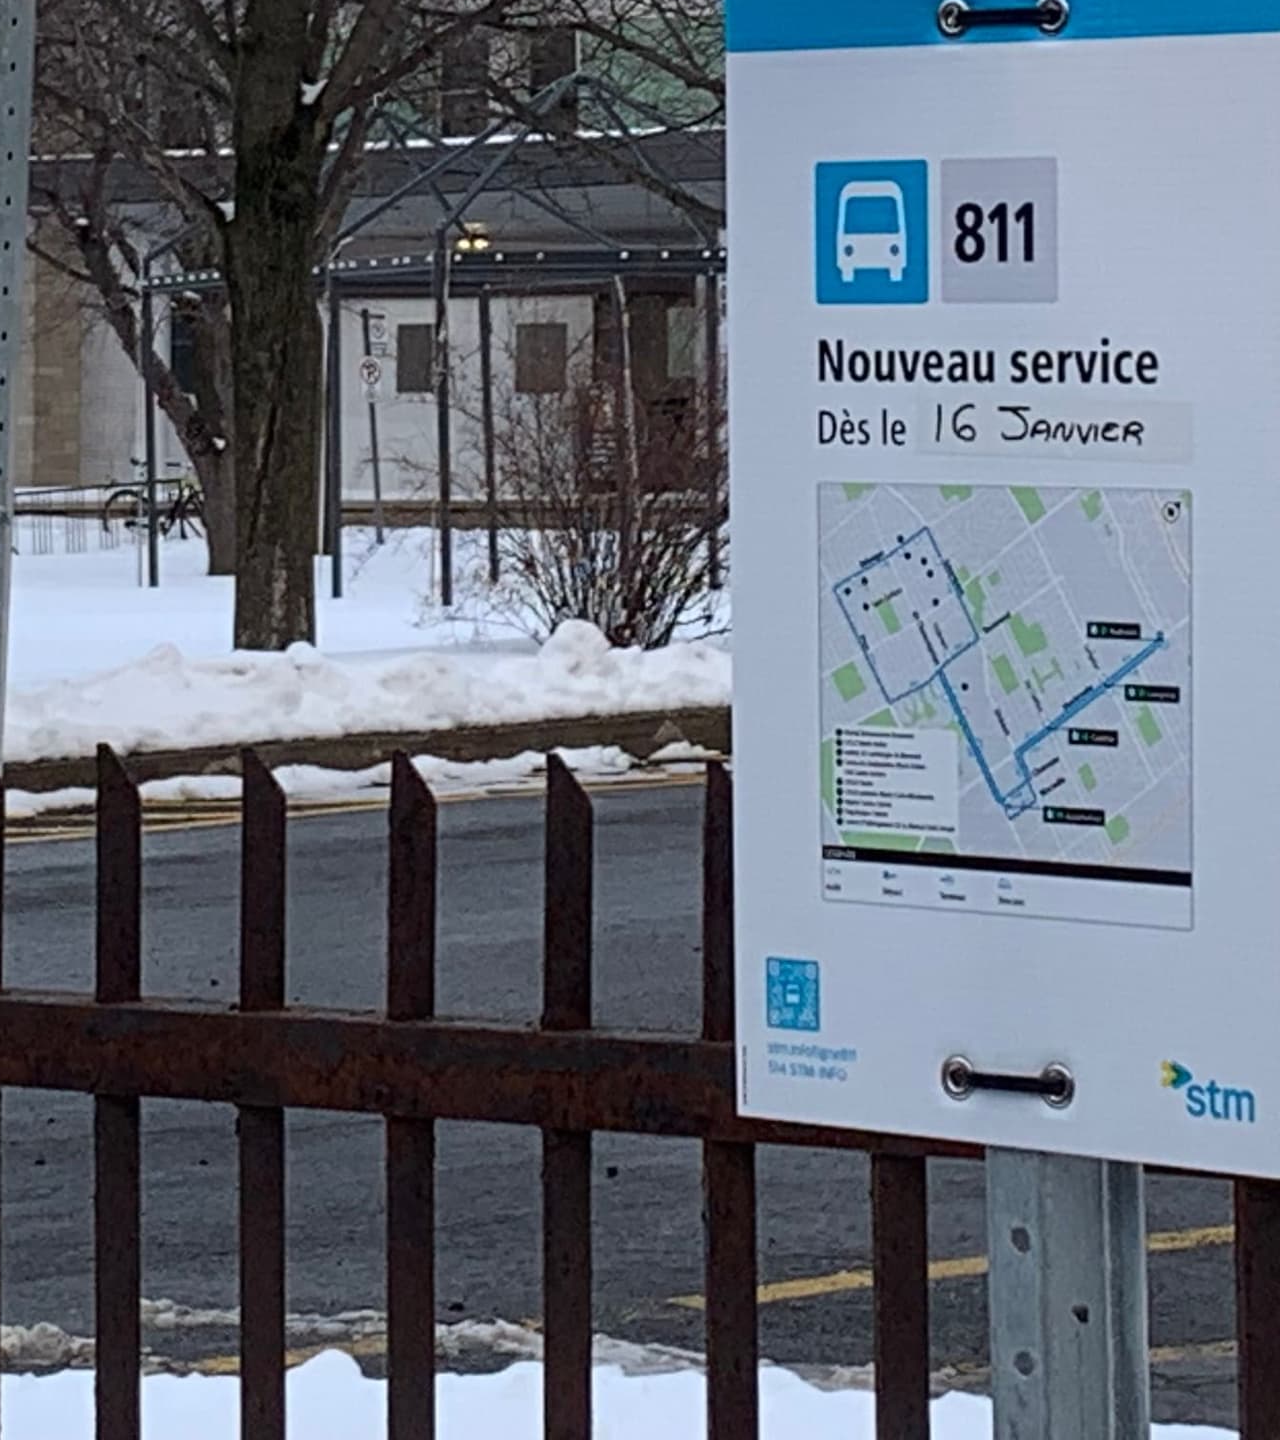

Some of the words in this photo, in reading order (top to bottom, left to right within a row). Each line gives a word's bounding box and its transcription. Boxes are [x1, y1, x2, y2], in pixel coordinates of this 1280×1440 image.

[953, 201, 1036, 263] 811
[817, 337, 996, 384] Nouveau
[1009, 337, 1160, 386] service
[817, 409, 871, 446] Dès
[881, 408, 908, 446] le
[933, 403, 978, 444] 16
[996, 403, 1146, 447] JANVIER
[1185, 1079, 1256, 1124] stm
